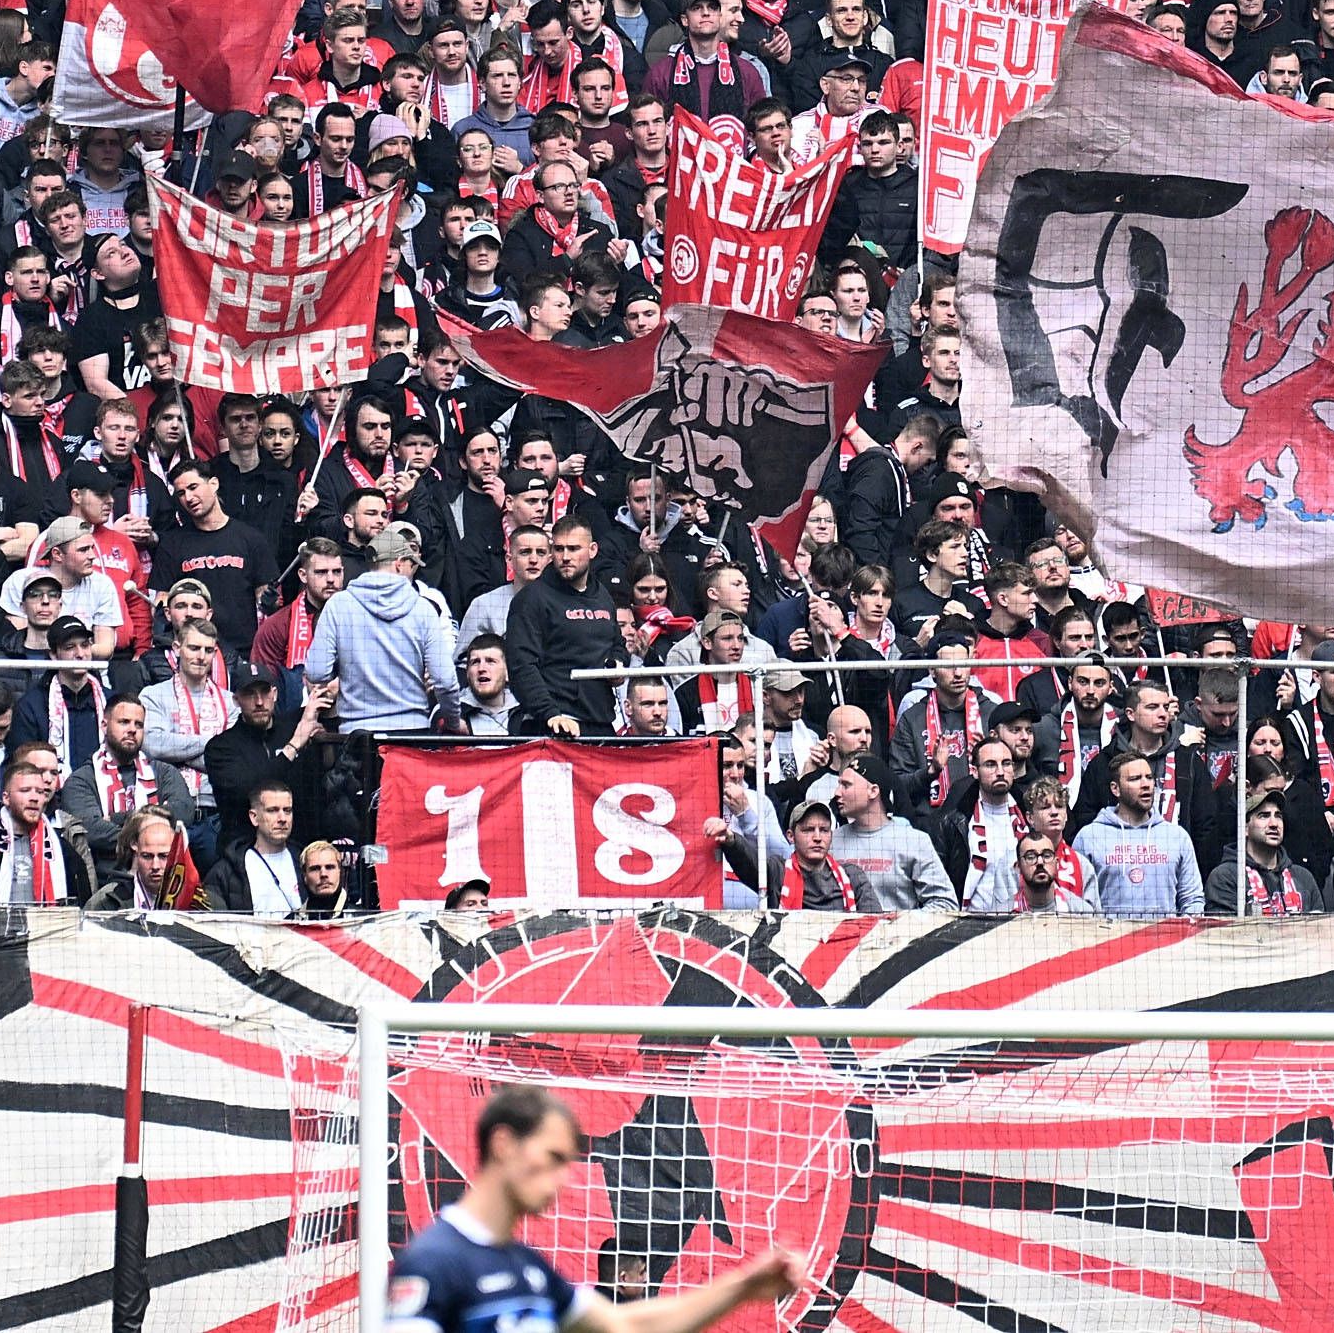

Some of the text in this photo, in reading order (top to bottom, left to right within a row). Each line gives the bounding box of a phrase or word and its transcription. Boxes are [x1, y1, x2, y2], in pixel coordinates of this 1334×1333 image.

[936, 2, 1069, 81] HEUT
[149, 179, 395, 268] FORTUNA
[204, 263, 328, 333] PER
[701, 237, 784, 317] FÜR
[168, 316, 369, 395] SEMPRE
[424, 783, 686, 887] 1 8
[1114, 844, 1133, 854] AUF
